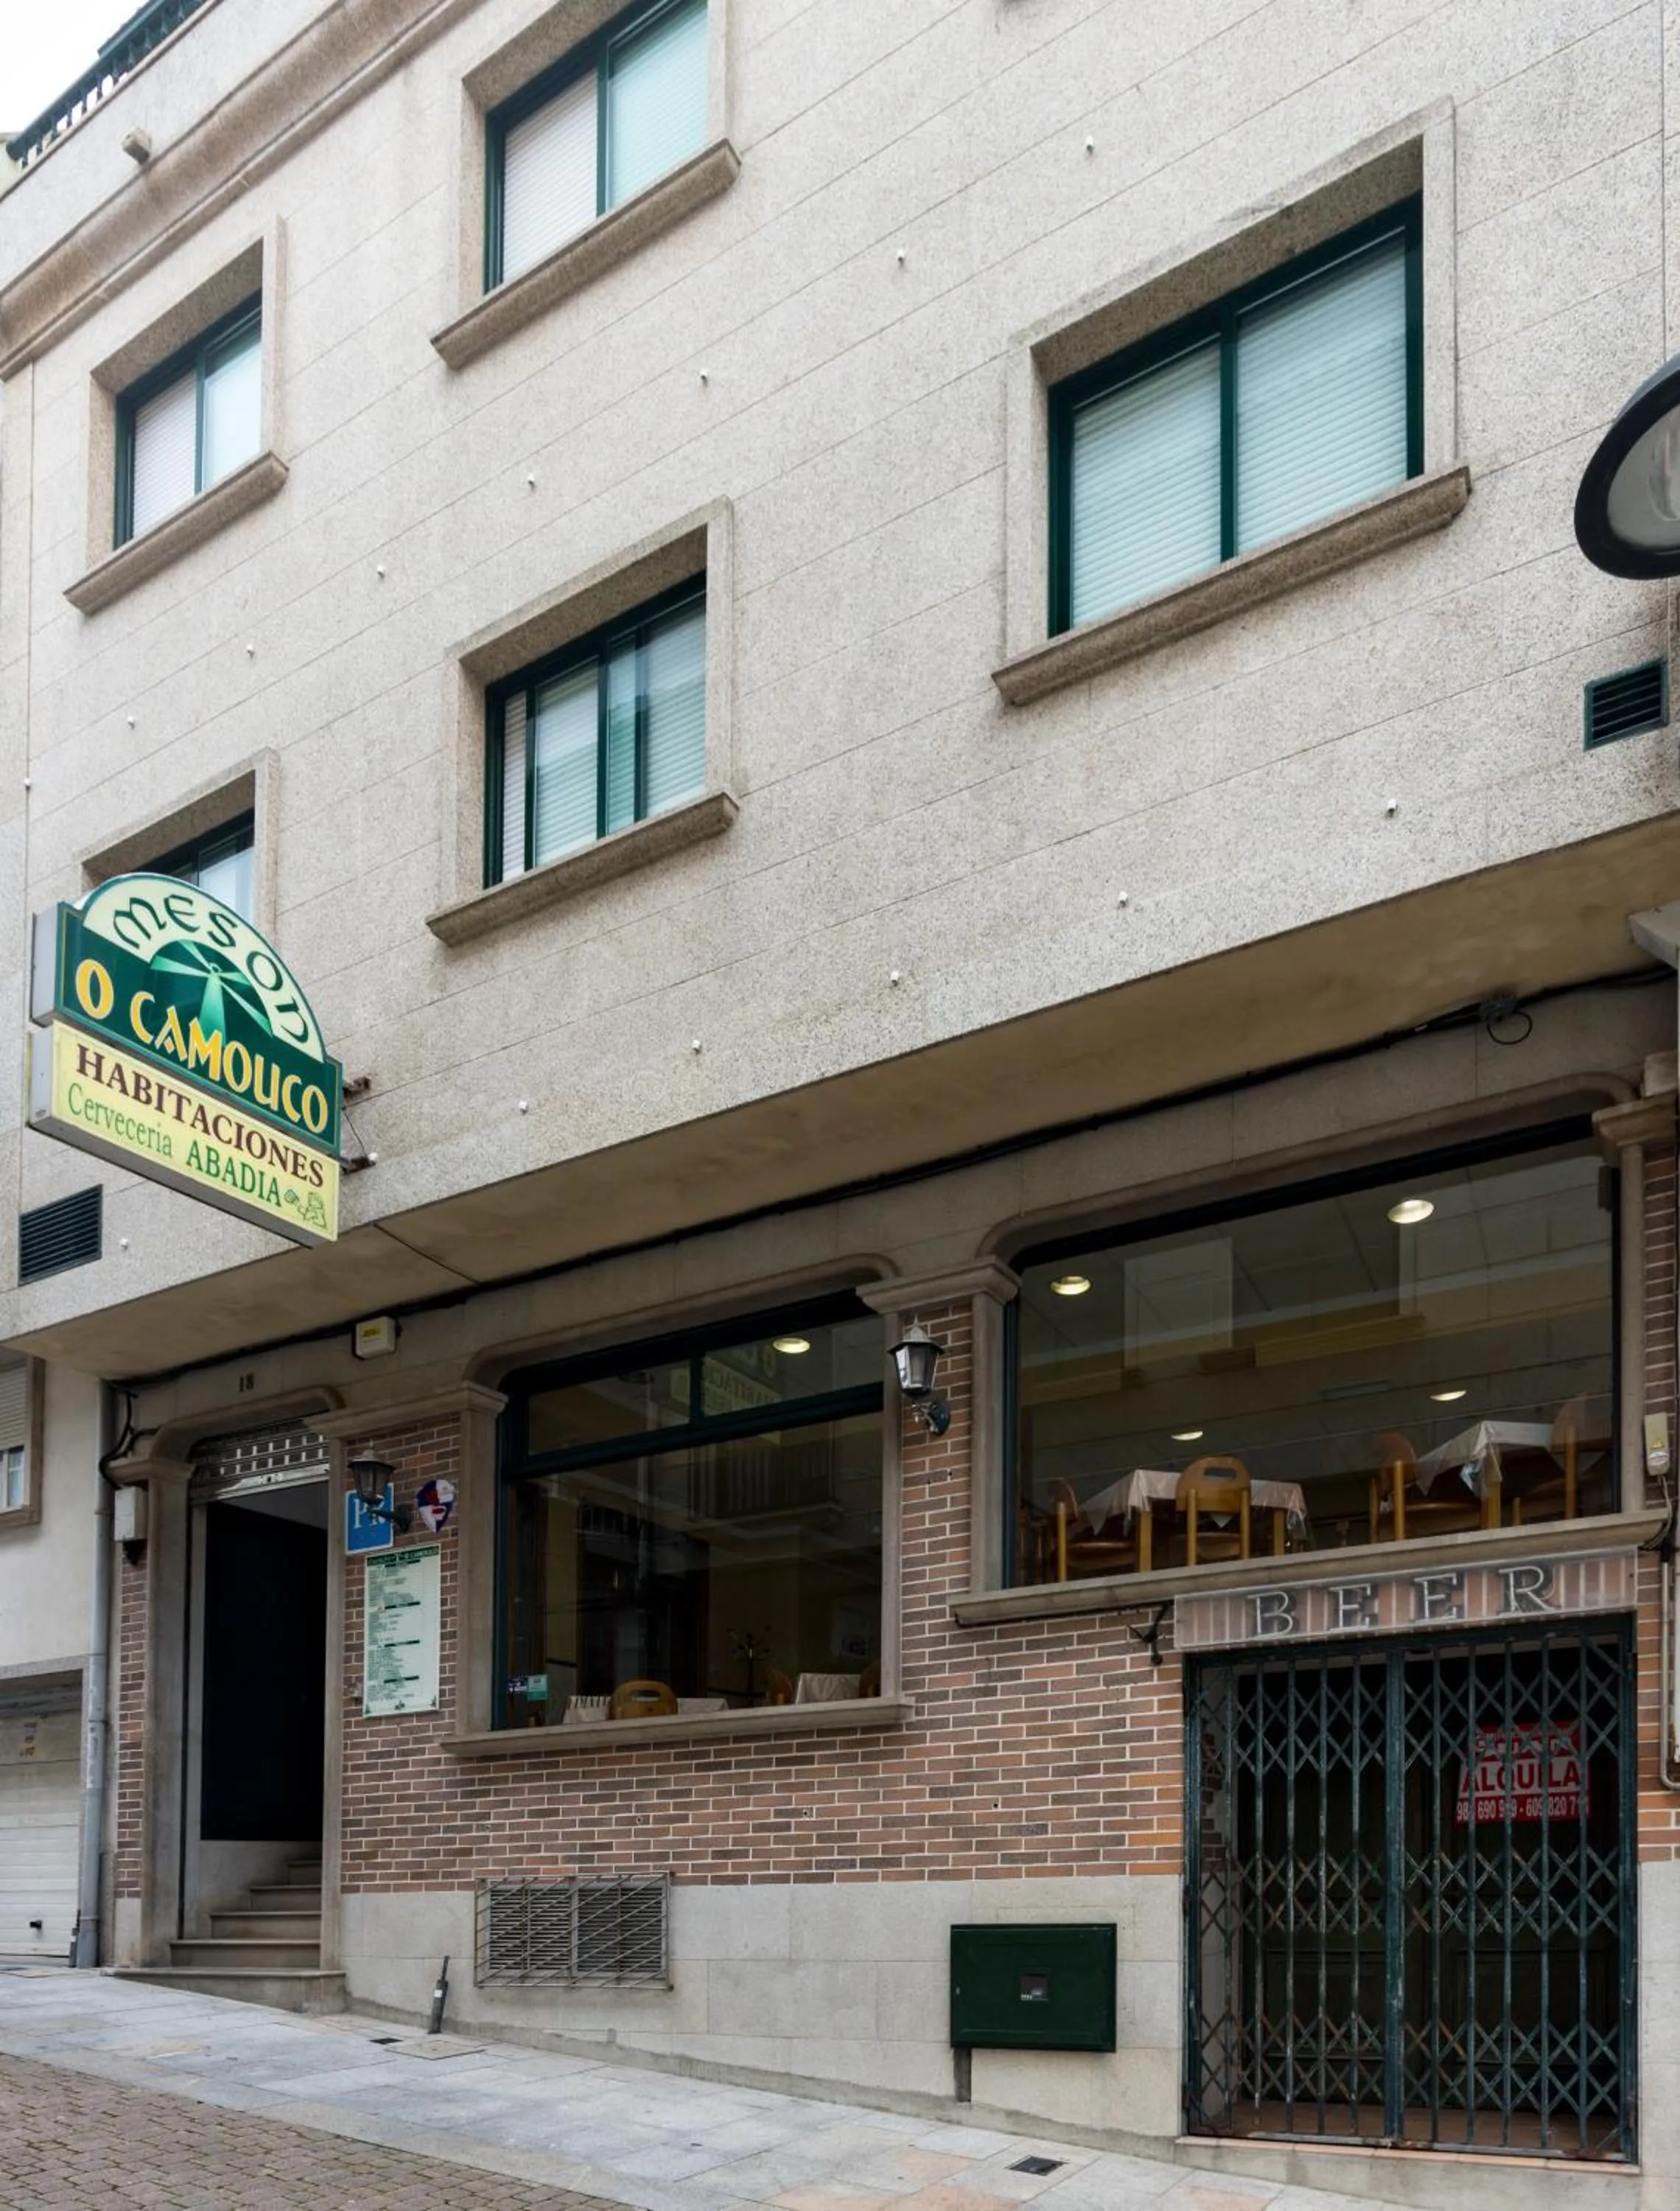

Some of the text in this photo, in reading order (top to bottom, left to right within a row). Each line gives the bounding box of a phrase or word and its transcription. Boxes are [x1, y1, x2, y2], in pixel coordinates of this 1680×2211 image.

[113, 894, 309, 1045] MESON
[75, 958, 329, 1134] O CAMOUCO
[76, 1043, 324, 1189] HABITACIONES
[186, 1140, 283, 1207] ABADIA
[239, 1372, 254, 1392] 18
[1247, 1565, 1564, 1638] BEER
[1456, 1800, 1474, 1821] 98
[1477, 1799, 1497, 1820] 690
[1499, 1798, 1517, 1819] 99
[1461, 1760, 1581, 1792] ALQUILA
